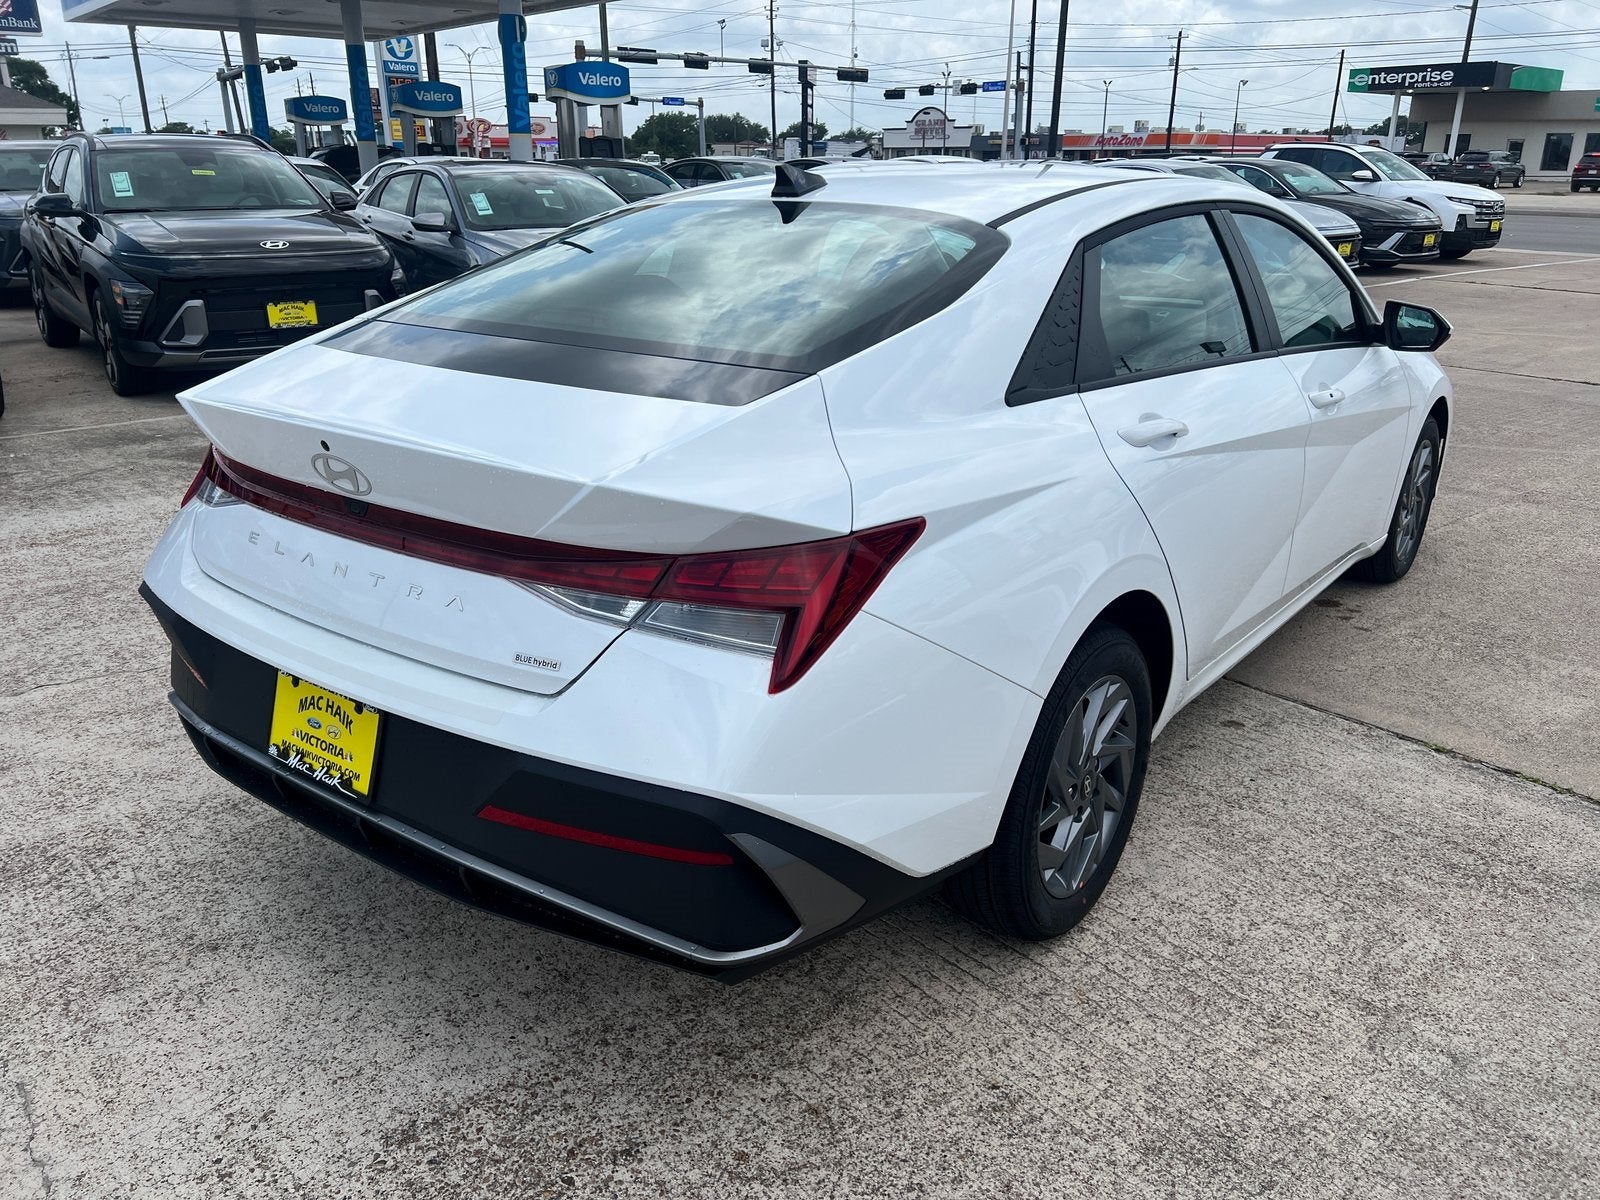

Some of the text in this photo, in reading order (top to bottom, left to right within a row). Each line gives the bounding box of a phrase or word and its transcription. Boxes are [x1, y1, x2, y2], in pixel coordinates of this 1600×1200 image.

[0, 17, 38, 28] nBank
[388, 62, 416, 72] Valero
[578, 72, 622, 87] Valero
[1350, 68, 1454, 86] enterprise
[414, 91, 454, 102] Valero
[304, 103, 340, 113] Valero
[1095, 134, 1143, 146] AutoZone
[248, 530, 464, 612] ELANTRA
[515, 653, 558, 669] BLUE hybrid
[298, 695, 324, 713] MAC
[325, 698, 354, 735] HAIK
[299, 729, 345, 760] VICTORIA
[287, 752, 313, 776] Mac
